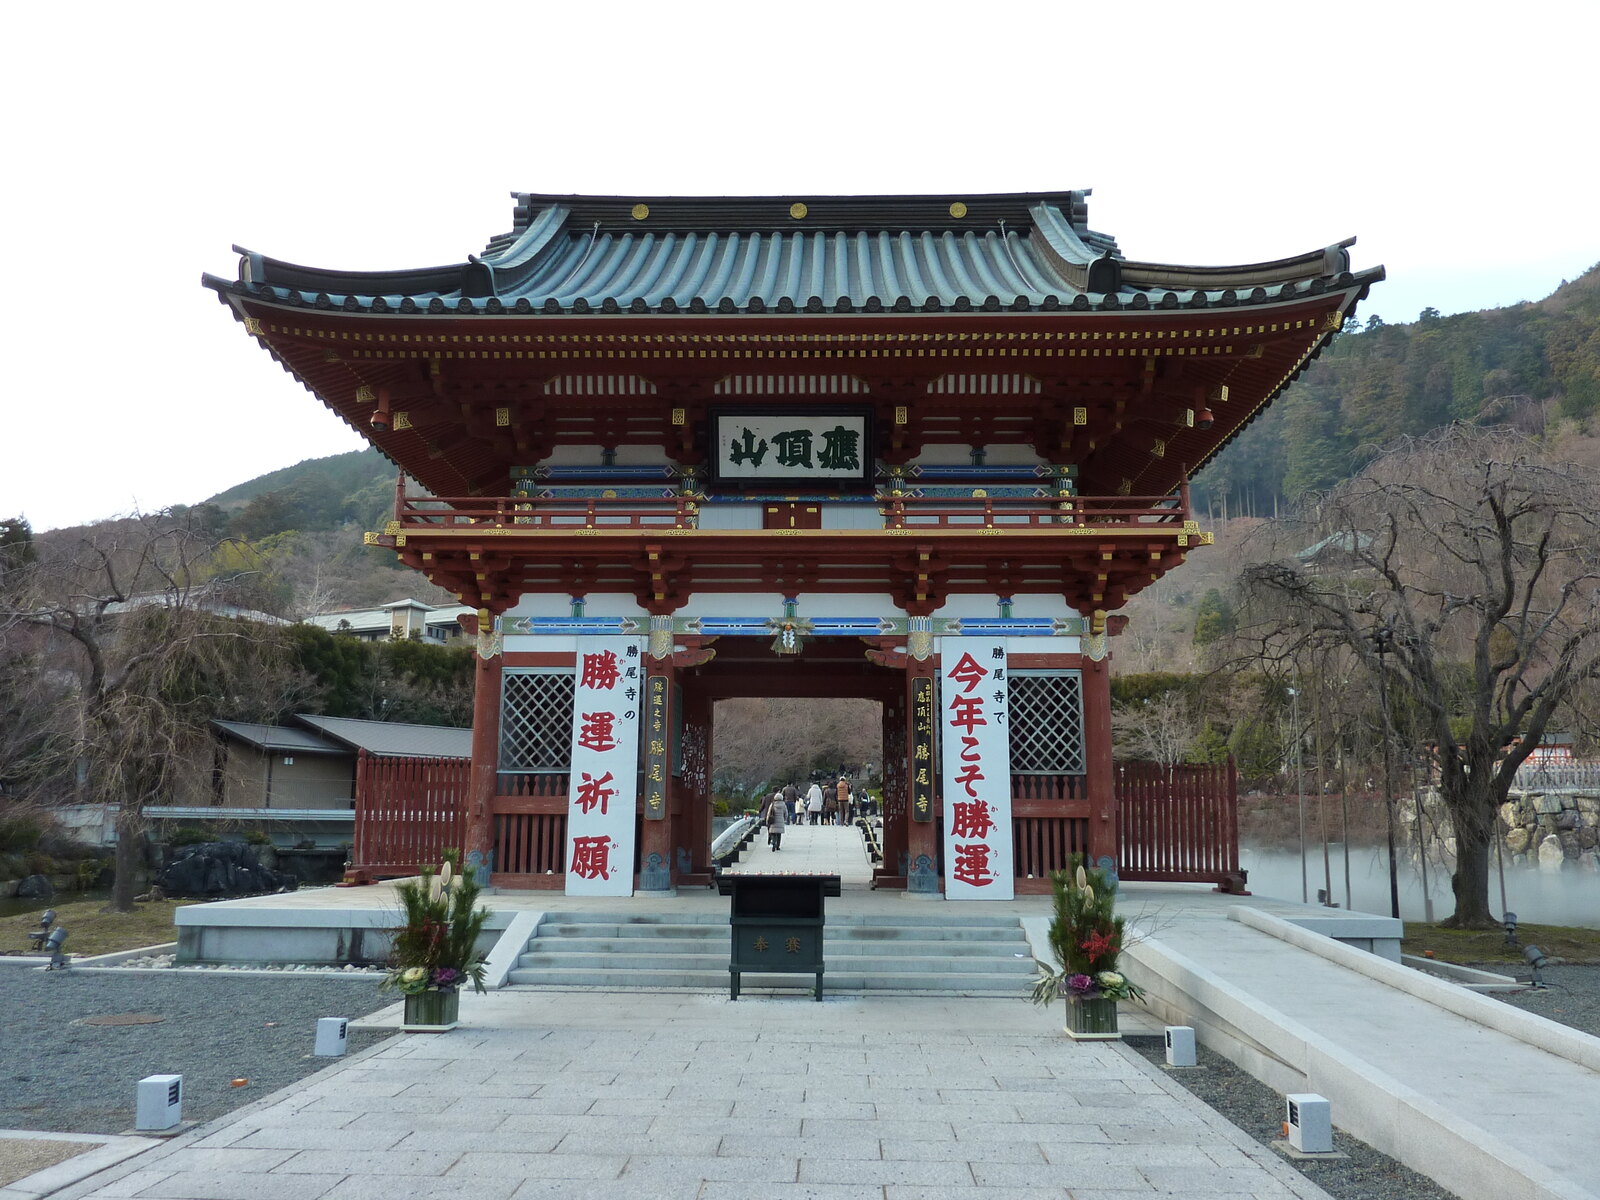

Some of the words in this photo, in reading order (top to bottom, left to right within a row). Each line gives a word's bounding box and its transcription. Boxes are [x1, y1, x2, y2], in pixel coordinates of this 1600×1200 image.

[624, 644, 639, 720] 勝尾寺の
[992, 646, 1005, 724] 勝尾寺で
[570, 649, 621, 881] 勝運祈願
[914, 744, 930, 813] 勝尾寺
[947, 652, 994, 887] 今年こそ勝運
